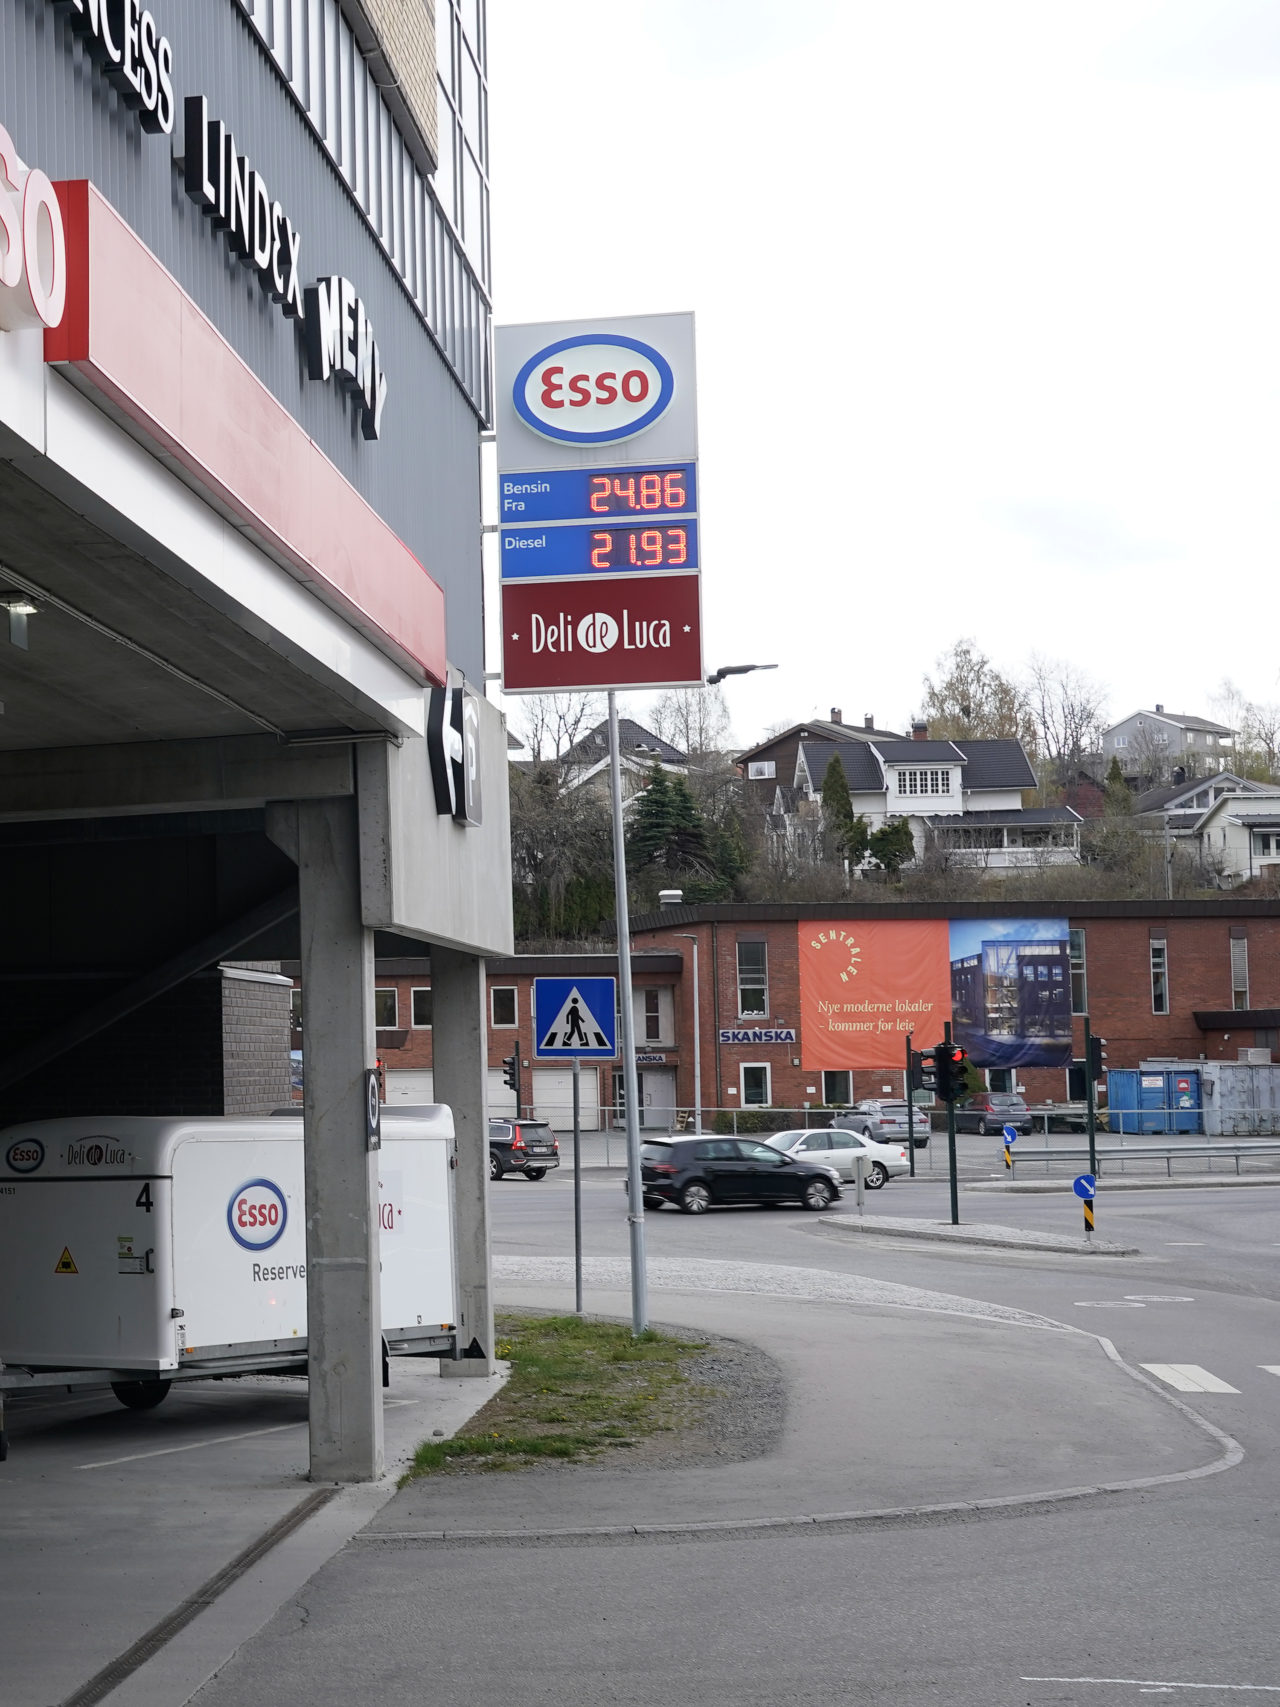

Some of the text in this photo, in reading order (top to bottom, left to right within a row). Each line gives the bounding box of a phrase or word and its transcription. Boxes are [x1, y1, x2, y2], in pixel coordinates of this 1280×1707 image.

[198, 95, 303, 319] LINDEX
[315, 275, 388, 440] MENY
[503, 473, 686, 512] Bensin 24.86
[504, 498, 525, 512] Fra
[504, 529, 687, 568] Diesel 21.93
[531, 609, 671, 653] Deli de Luca
[811, 930, 862, 982] SENTRALEN
[817, 1000, 934, 1017] Nye moderne lokaler
[720, 1030, 794, 1042] SKANSKA
[828, 1019, 874, 1031] kommer
[876, 1018, 894, 1034] for
[896, 1018, 915, 1031] leie
[67, 1144, 85, 1165] Deli
[105, 1143, 125, 1165] Luca
[135, 1182, 154, 1213] 4
[252, 1263, 306, 1282] Reserve
